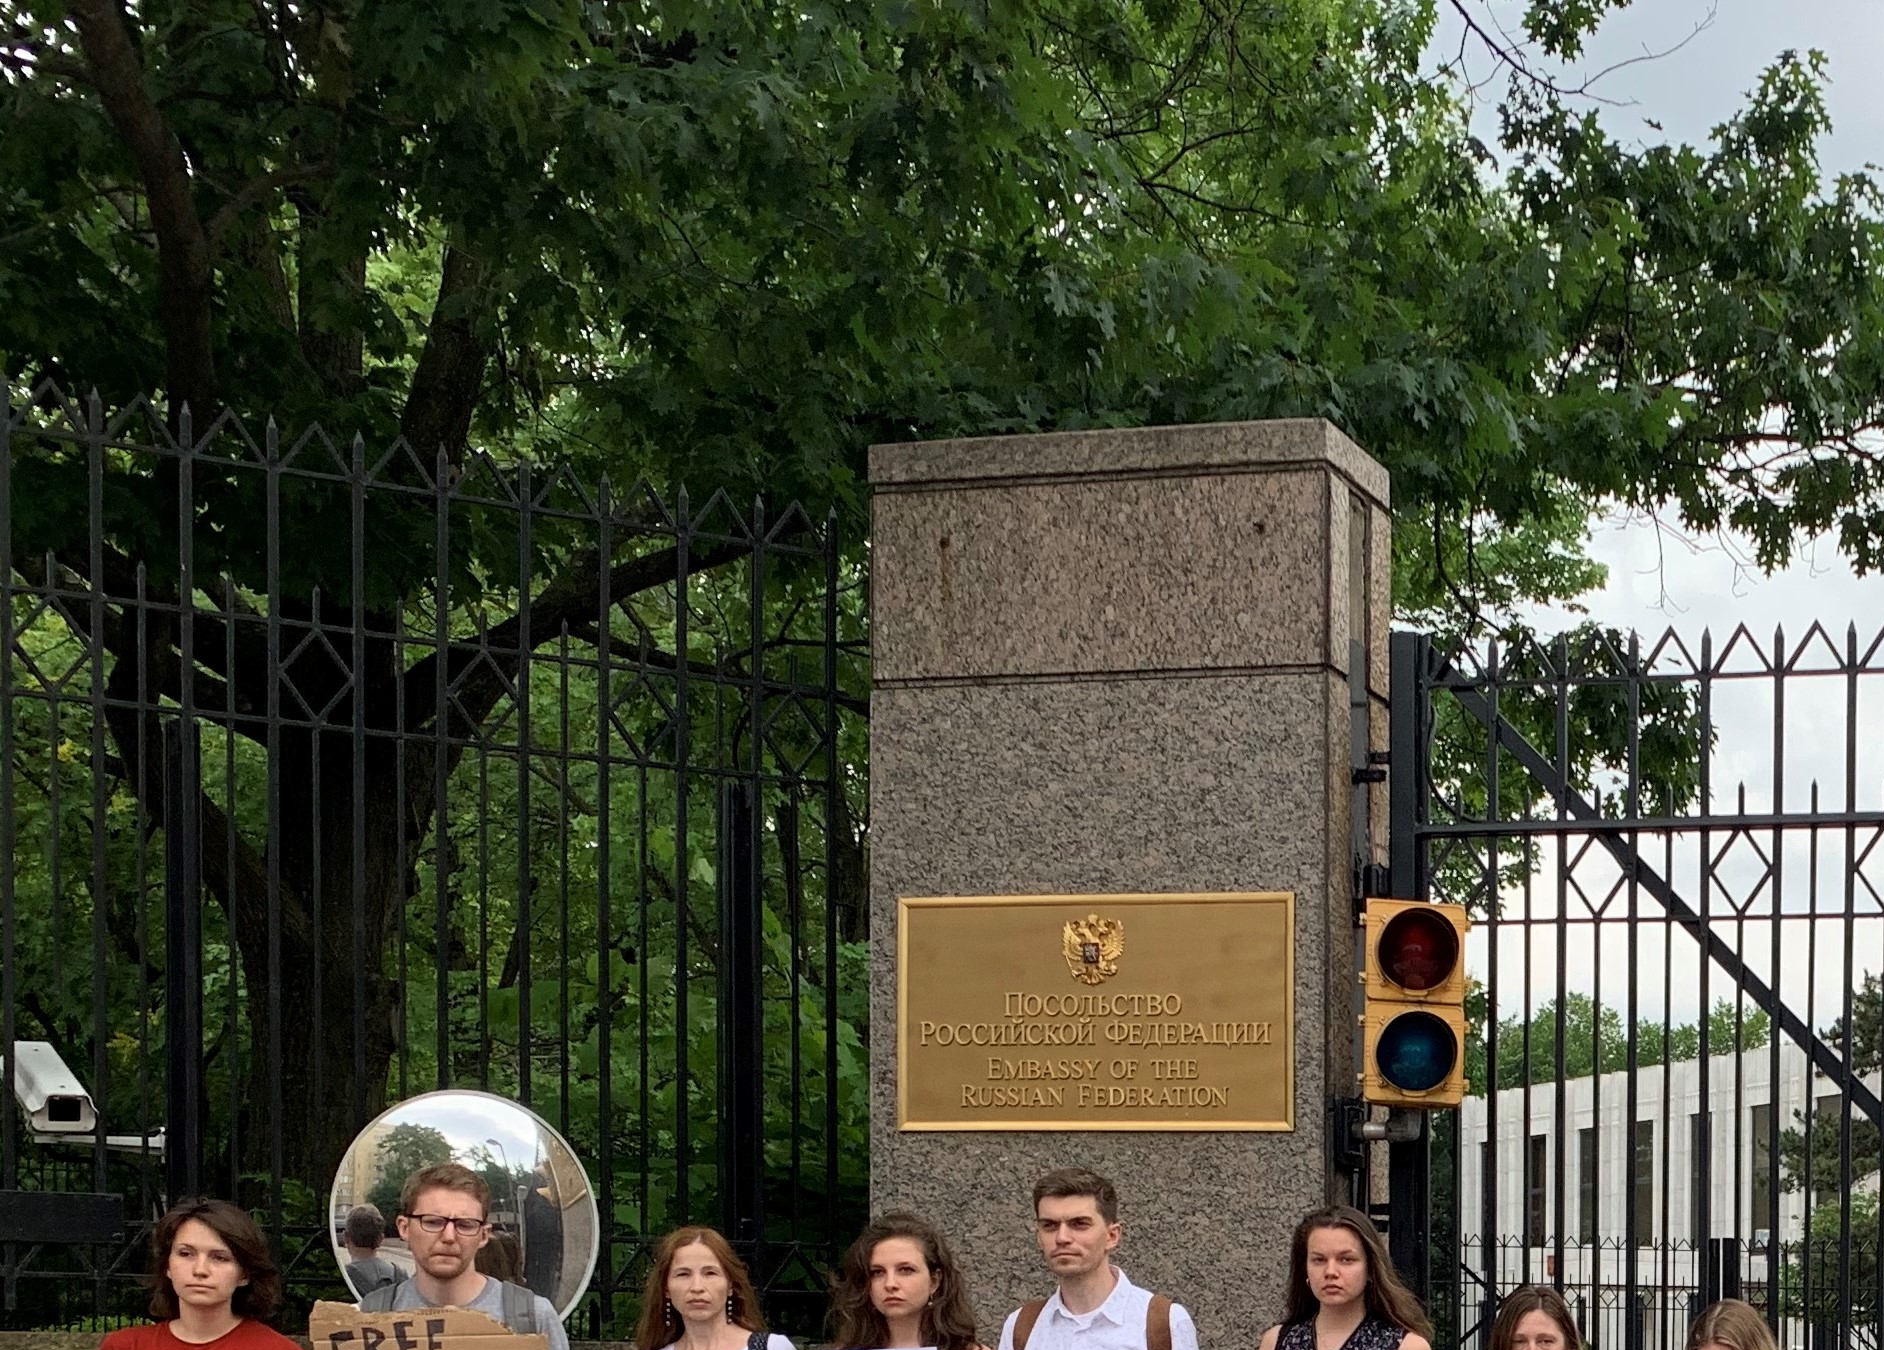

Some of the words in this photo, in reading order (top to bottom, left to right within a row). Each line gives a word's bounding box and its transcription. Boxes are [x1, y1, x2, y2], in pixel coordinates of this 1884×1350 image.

[1003, 991, 1182, 1018] ПОСОЛЬСТВО
[920, 1018, 1095, 1046] РОССИЙСКОЙ
[1104, 1019, 1272, 1049] ФЕДЕРАЦИИ
[987, 1057, 1102, 1080] EMBASSY
[1109, 1059, 1138, 1080] OF
[1150, 1058, 1199, 1080] THE
[961, 1083, 1064, 1108] RUSSIAN
[1077, 1083, 1229, 1107] FEDERATION
